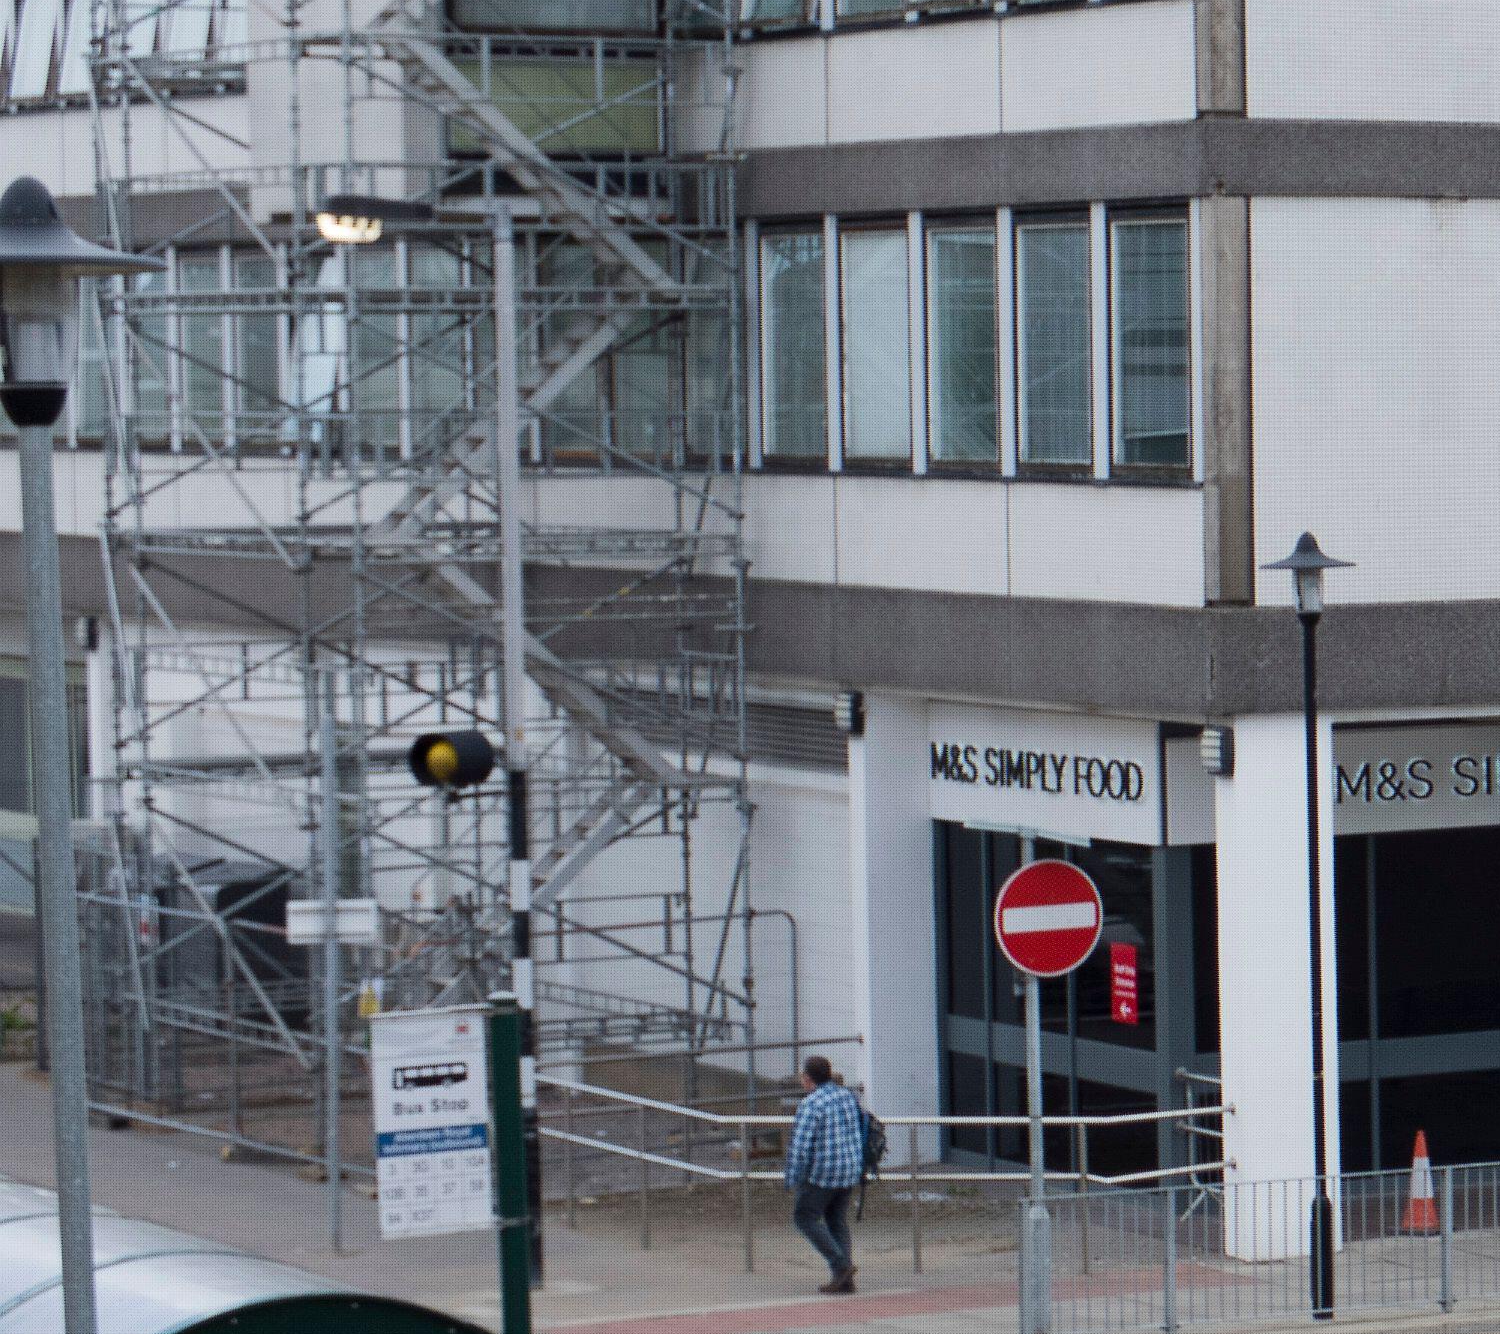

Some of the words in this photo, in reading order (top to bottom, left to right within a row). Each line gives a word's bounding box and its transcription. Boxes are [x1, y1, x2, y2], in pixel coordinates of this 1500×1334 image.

[931, 742, 978, 783] M&S
[985, 747, 1068, 794] SIMPLY
[1074, 756, 1144, 801] FOOD
[1335, 758, 1434, 804] M&S
[393, 1102, 424, 1117] Bus
[431, 1097, 469, 1115] Stop
